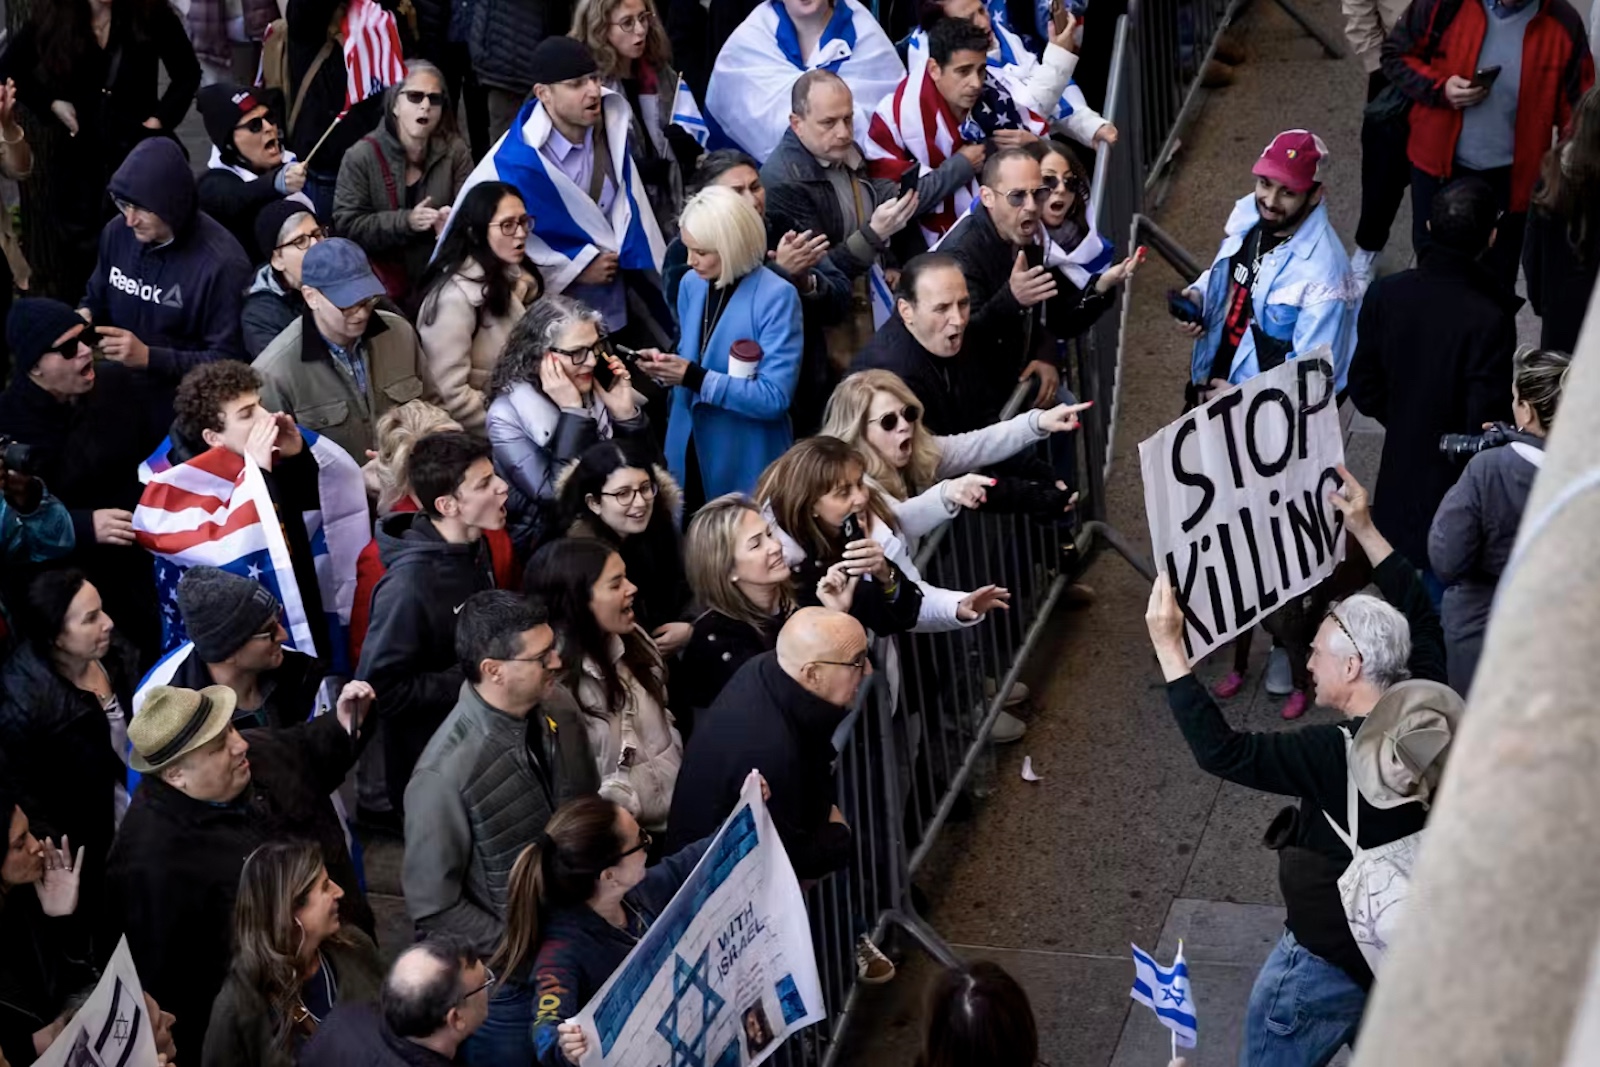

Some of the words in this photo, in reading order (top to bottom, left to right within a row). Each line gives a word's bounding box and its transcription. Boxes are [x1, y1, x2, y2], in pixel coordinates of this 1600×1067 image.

[1172, 358, 1335, 533] STOP
[716, 917, 765, 982] ISRAEL
[717, 901, 754, 951] WITH
